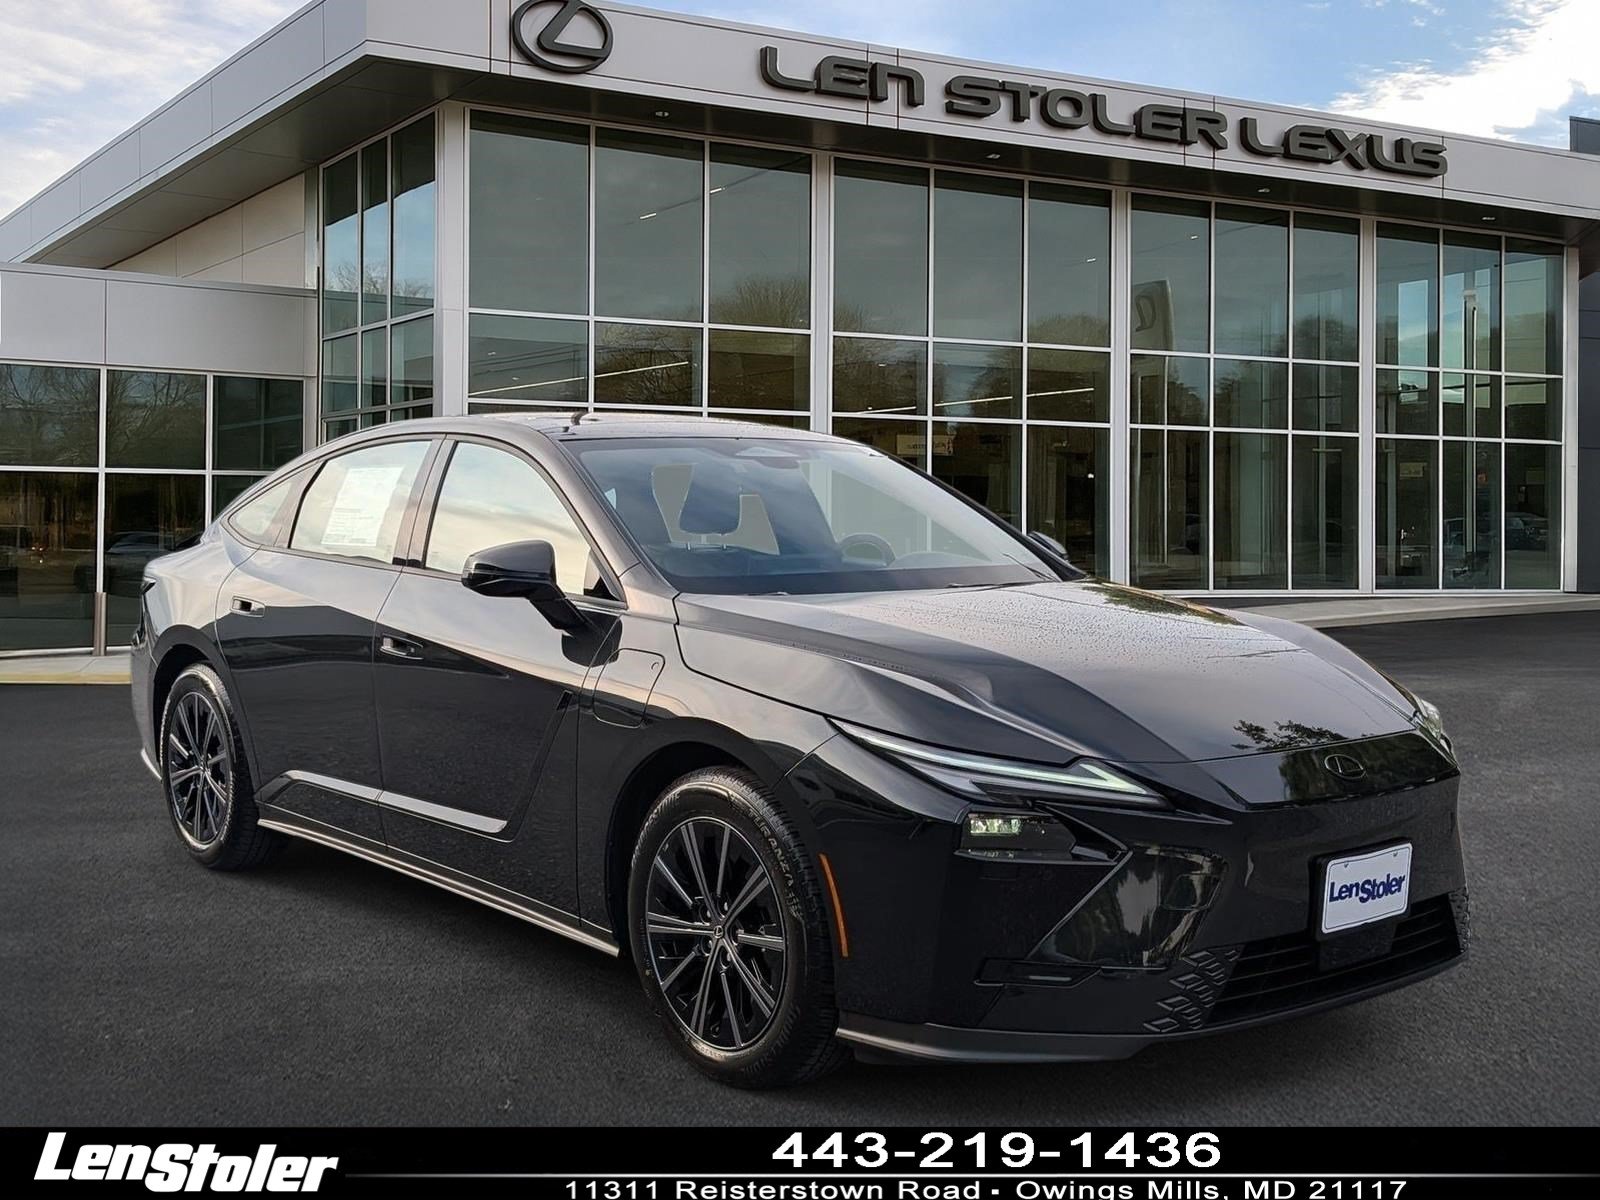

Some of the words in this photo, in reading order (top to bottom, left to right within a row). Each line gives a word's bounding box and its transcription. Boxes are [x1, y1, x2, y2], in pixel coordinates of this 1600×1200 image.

[760, 45, 925, 106] LEN
[945, 74, 1228, 150] STOLER
[1239, 116, 1448, 178] LEXUS
